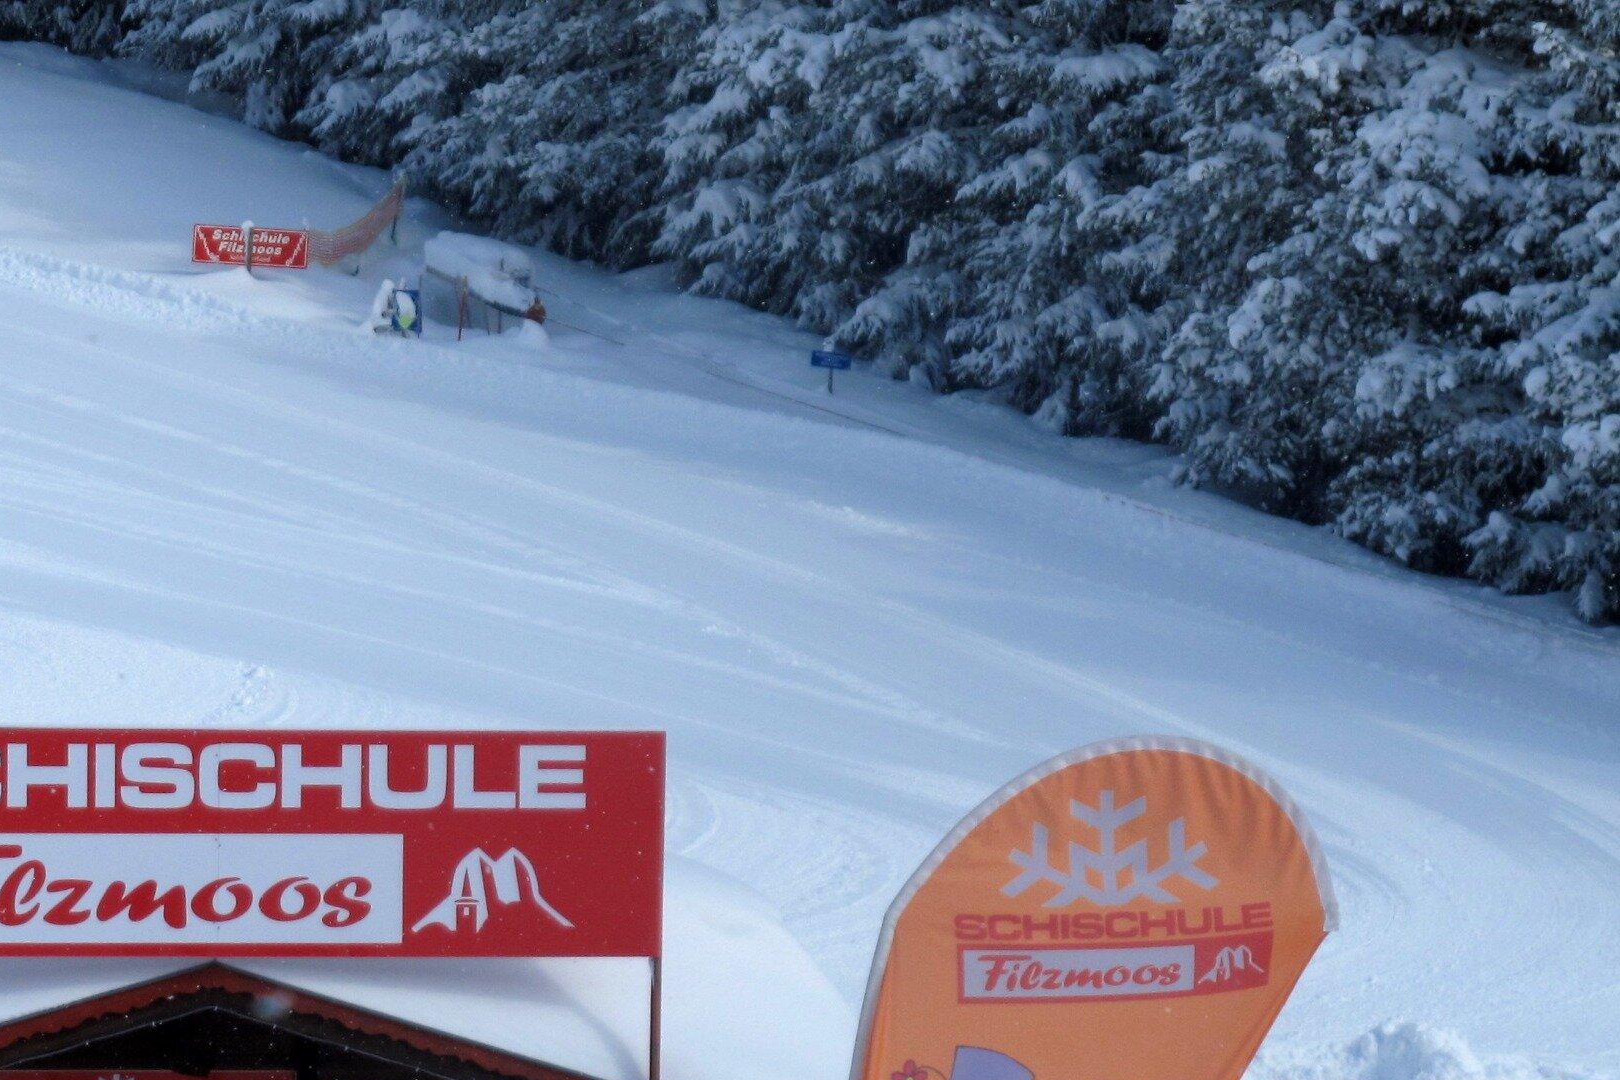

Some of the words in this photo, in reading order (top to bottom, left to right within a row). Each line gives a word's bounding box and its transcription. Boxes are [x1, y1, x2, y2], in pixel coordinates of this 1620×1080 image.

[212, 228, 291, 245] Schichule
[953, 901, 1274, 941] SCHISCHULE
[977, 953, 1182, 992] Filzmoos
